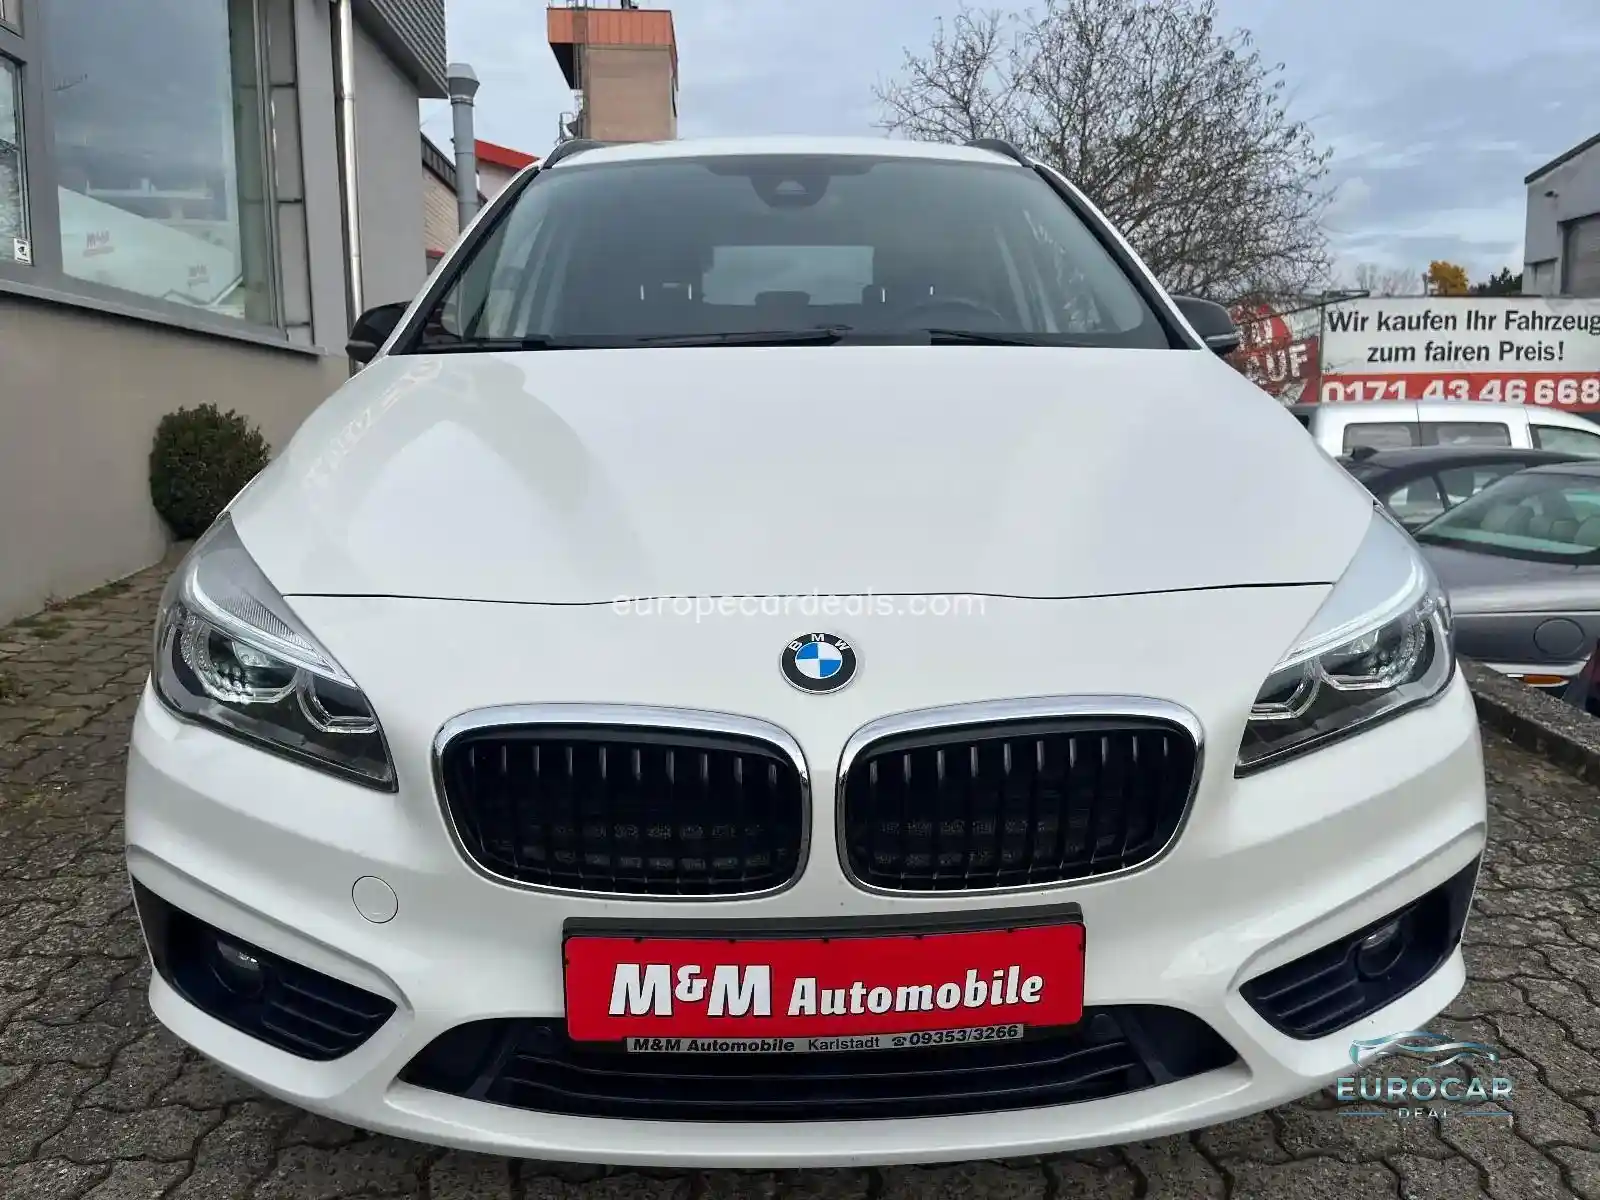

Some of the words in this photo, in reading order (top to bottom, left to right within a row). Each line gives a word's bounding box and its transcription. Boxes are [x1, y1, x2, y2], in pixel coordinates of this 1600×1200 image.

[1328, 310, 1369, 332] Wir
[1377, 310, 1457, 331] kaufen
[1466, 310, 1497, 331] Ihr
[1504, 309, 1600, 336] Fahrzeug
[1367, 345, 1416, 362] zum
[1425, 341, 1490, 362] fairen
[1499, 340, 1564, 361] Preis!
[1322, 380, 1406, 402] 0171
[1422, 379, 1470, 402] 43
[1479, 379, 1527, 402] 46
[1534, 379, 1600, 405] 668
[789, 632, 850, 652] BMW
[608, 963, 773, 1017] M&M
[787, 965, 1043, 1017] Automobile
[633, 1038, 681, 1051] M&M
[687, 1038, 795, 1052] Automobile
[808, 1036, 880, 1051] Karlstadt
[909, 1024, 1019, 1046] 09353/3266
